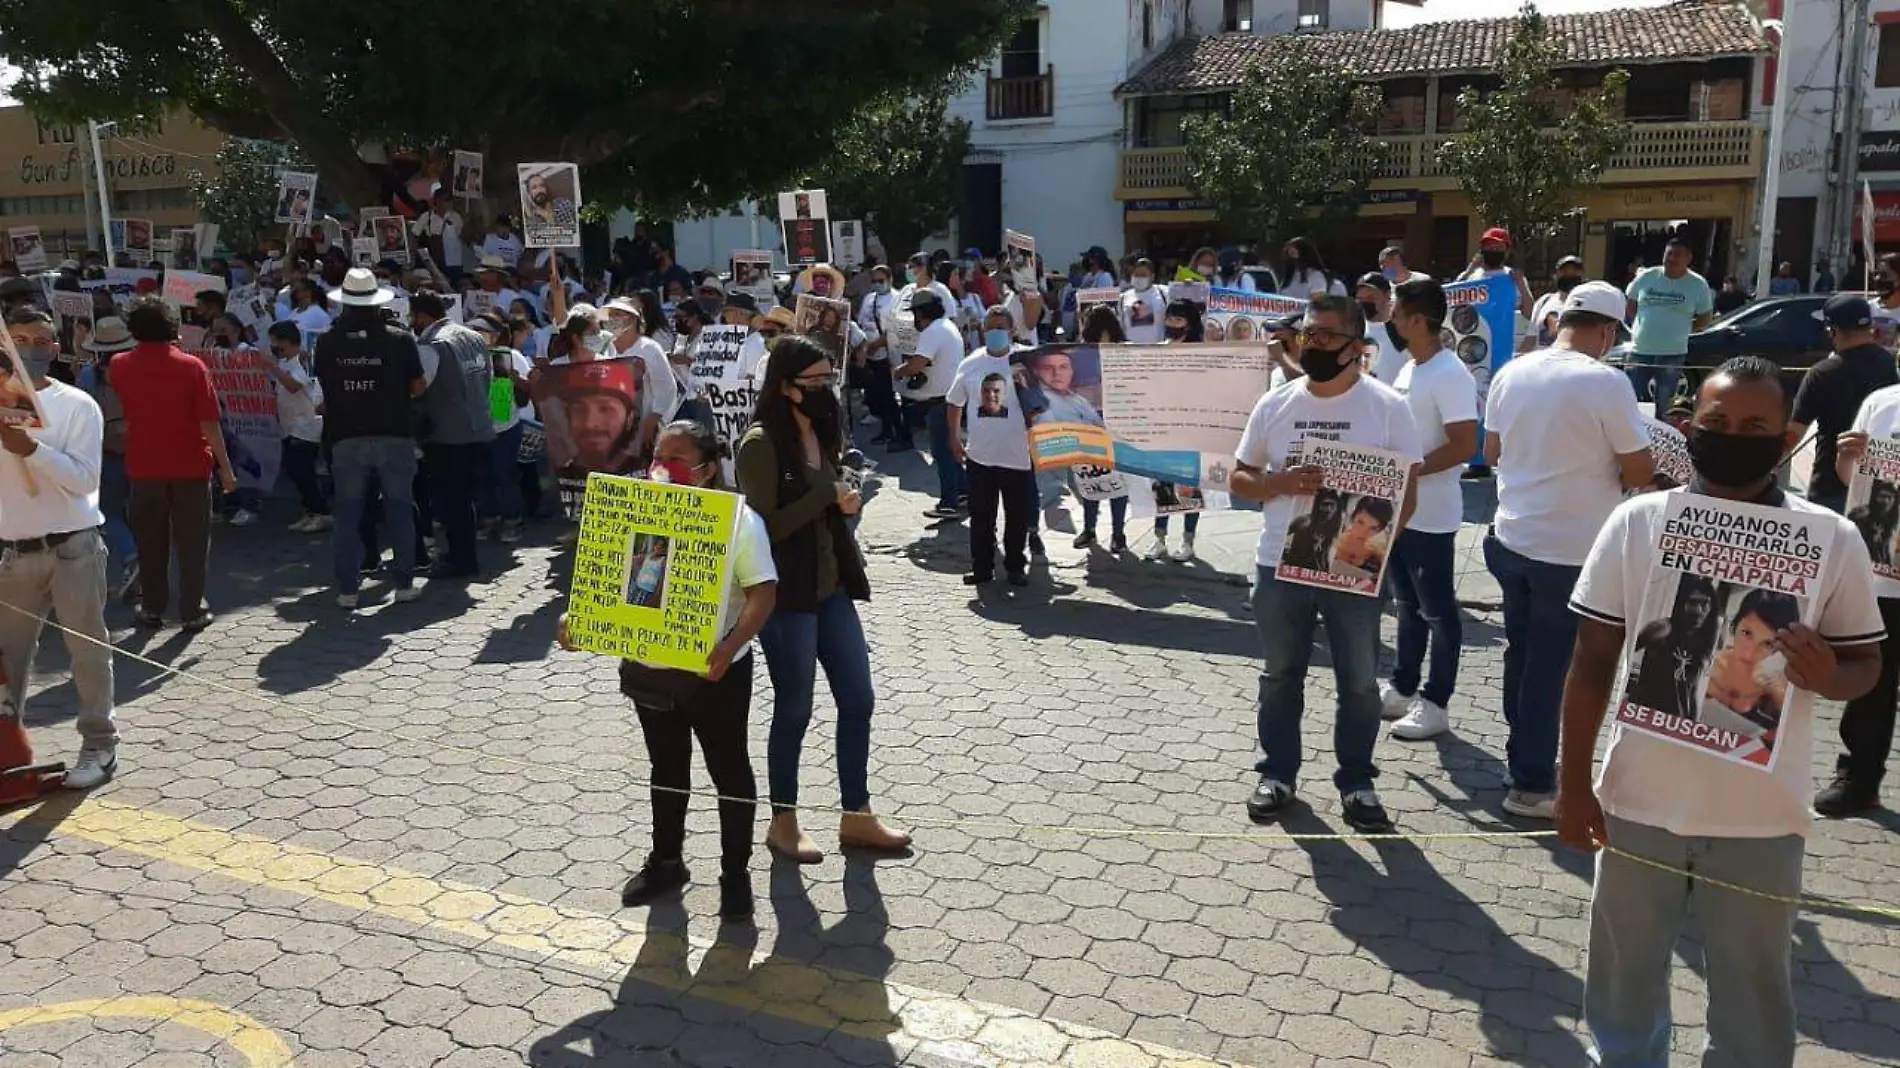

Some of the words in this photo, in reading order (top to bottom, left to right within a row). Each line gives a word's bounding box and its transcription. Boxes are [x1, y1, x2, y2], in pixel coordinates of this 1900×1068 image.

[344, 380, 376, 391] STAFF
[1305, 455, 1404, 480] ENCONTRARLOS
[1387, 458, 1396, 467] A
[1859, 465, 1880, 478] EN
[1324, 477, 1396, 499] CHAPALA
[1679, 506, 1792, 538] AYÚDANOS
[1794, 525, 1809, 541] A
[674, 539, 689, 551] UN
[1664, 520, 1823, 560] ENCONTRARLOS
[1661, 535, 1818, 577] DESAPARECIDOS
[1283, 566, 1300, 577] SE
[1303, 569, 1357, 588] BUSCAN
[1661, 551, 1692, 570] EN
[1697, 558, 1807, 595] CHAPALA
[664, 607, 672, 618] A
[569, 615, 581, 627] TE
[621, 625, 633, 640] UN
[677, 634, 689, 651] DE
[694, 640, 708, 655] MI
[664, 620, 700, 636] FAMILIA
[597, 637, 617, 651] CON
[620, 642, 632, 655] EL
[1624, 702, 1650, 722] SE
[1651, 710, 1739, 749] BUSCAN
